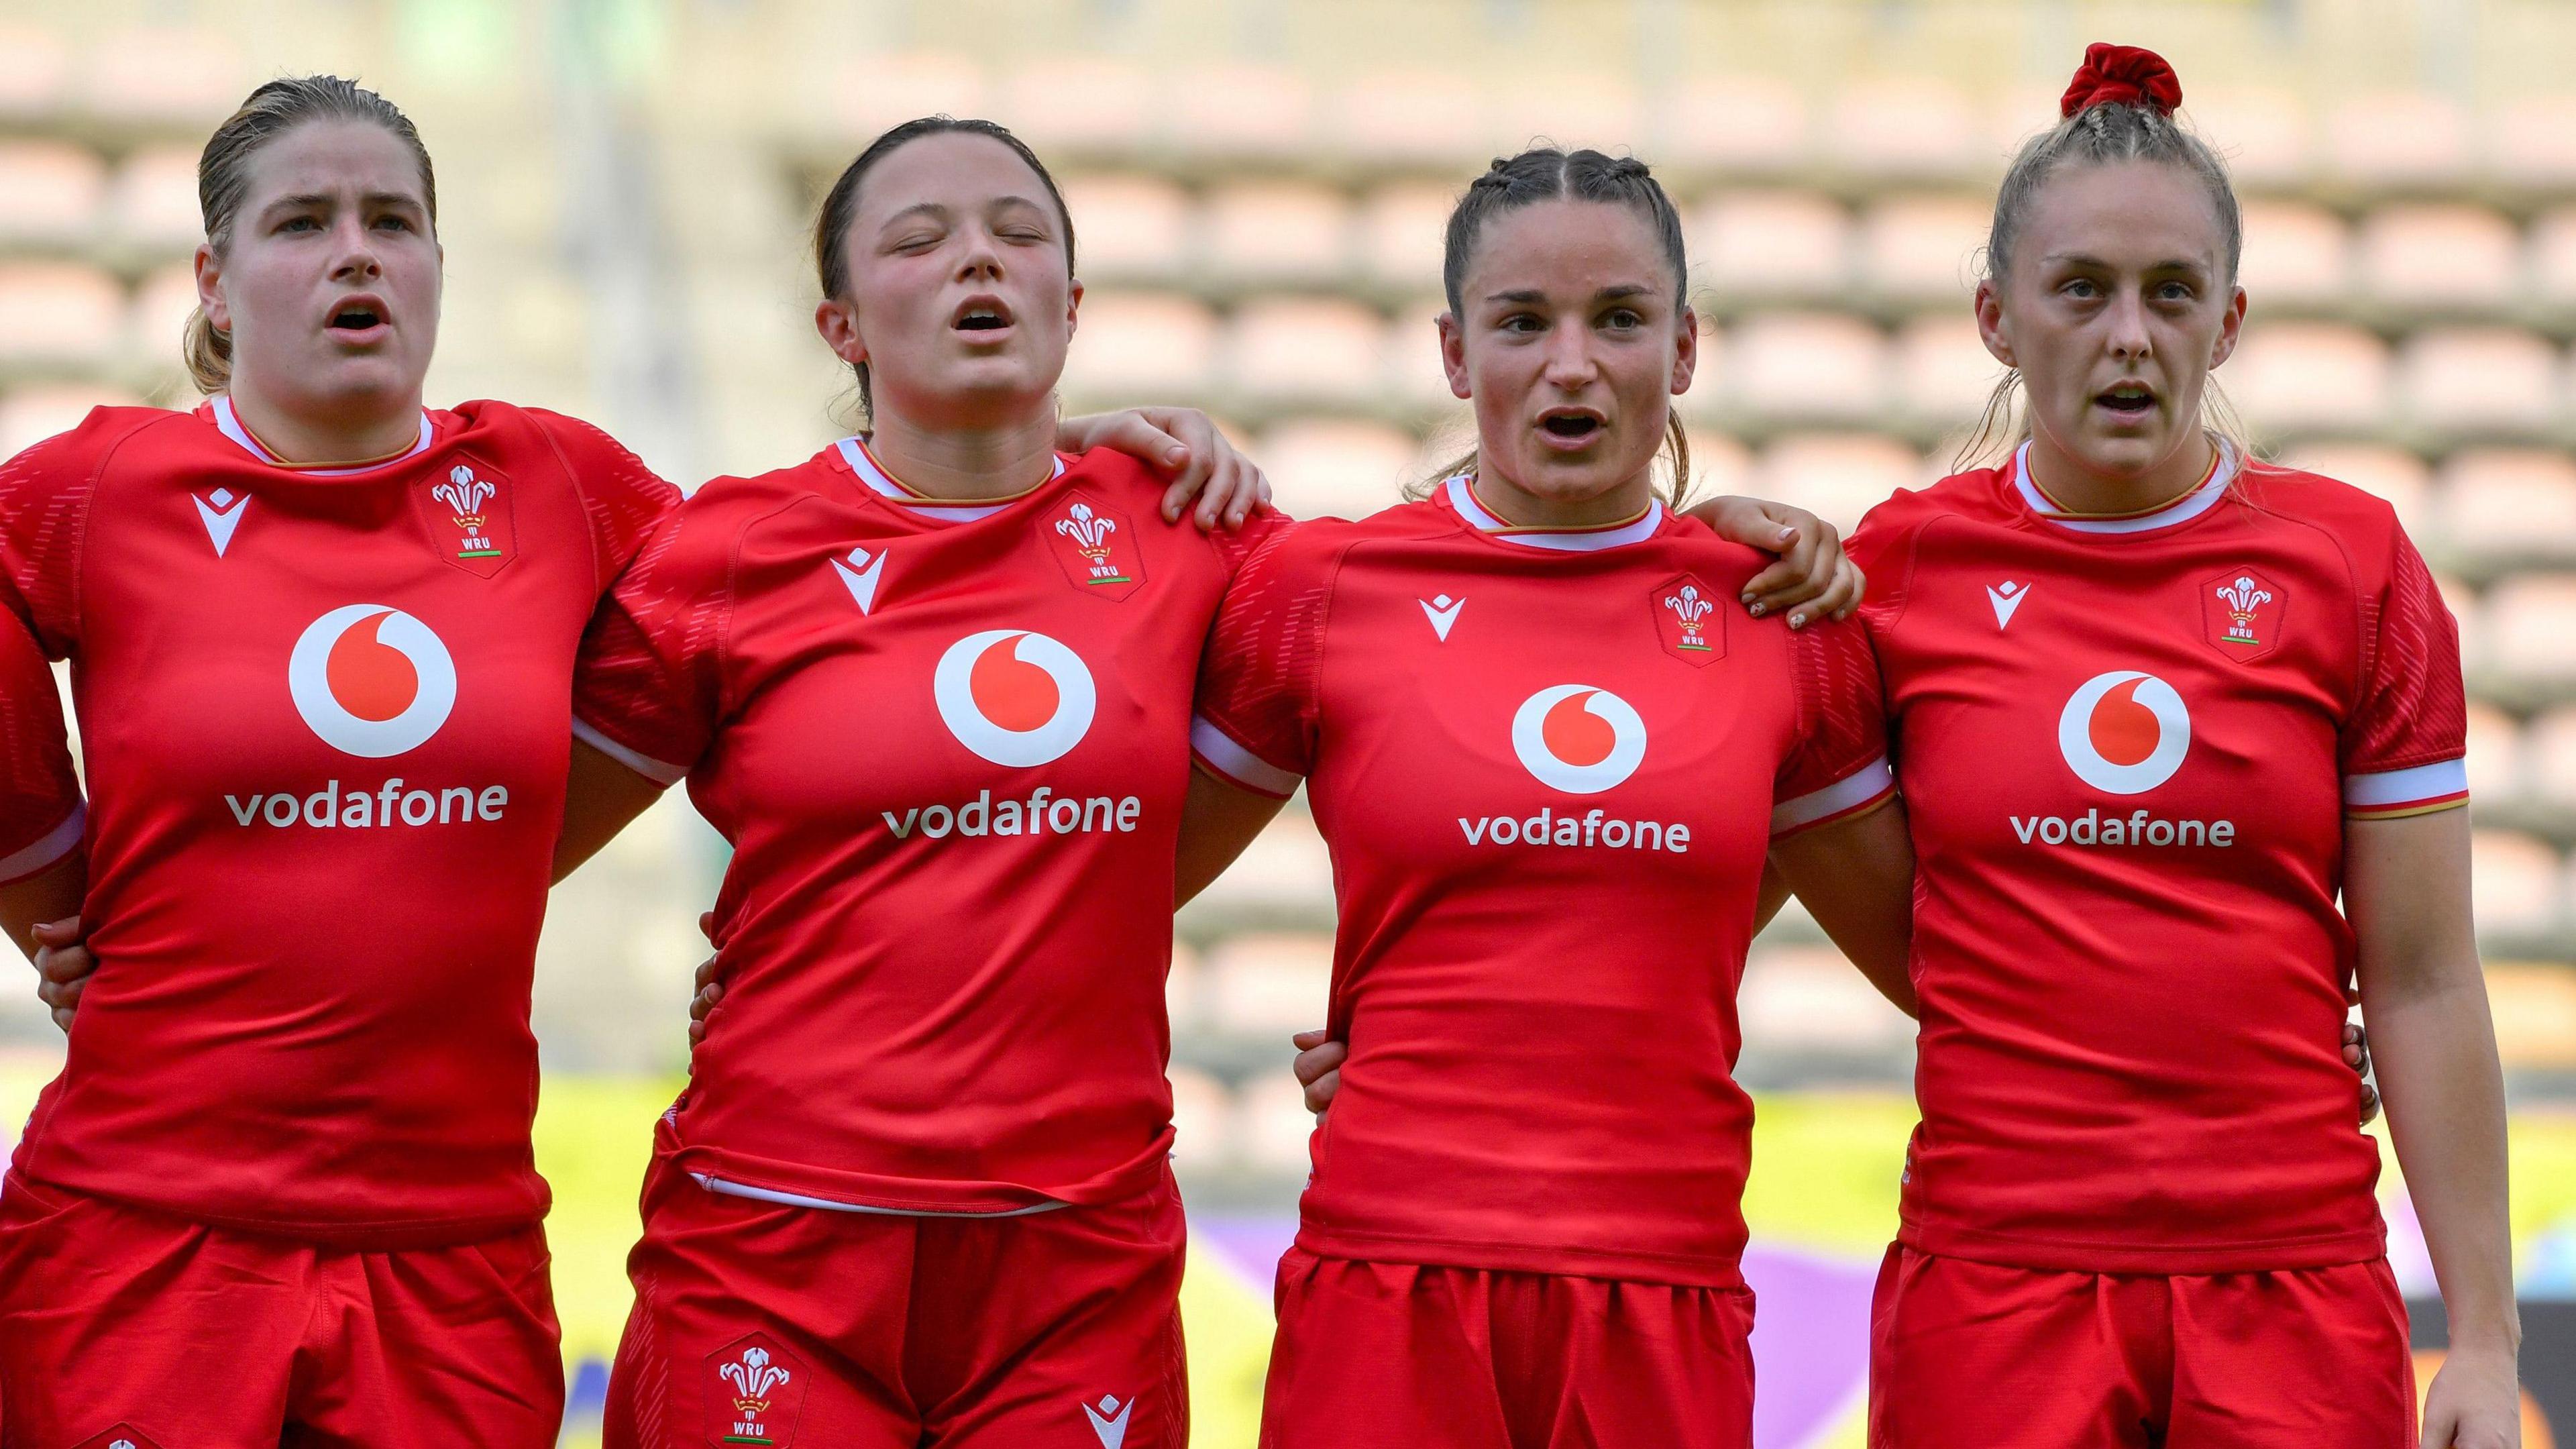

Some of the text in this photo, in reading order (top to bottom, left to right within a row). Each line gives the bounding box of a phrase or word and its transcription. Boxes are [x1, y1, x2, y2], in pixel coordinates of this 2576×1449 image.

[461, 536, 491, 550] WRU
[1089, 566, 1119, 578] WRU
[1682, 635, 1705, 645] WRU
[2229, 627, 2253, 639] WRU
[225, 777, 508, 828] vodafone
[881, 786, 1140, 839] vodafone
[1458, 807, 1690, 853] vodafone
[2010, 808, 2235, 846] vodafone
[733, 1421, 764, 1436] WRU
